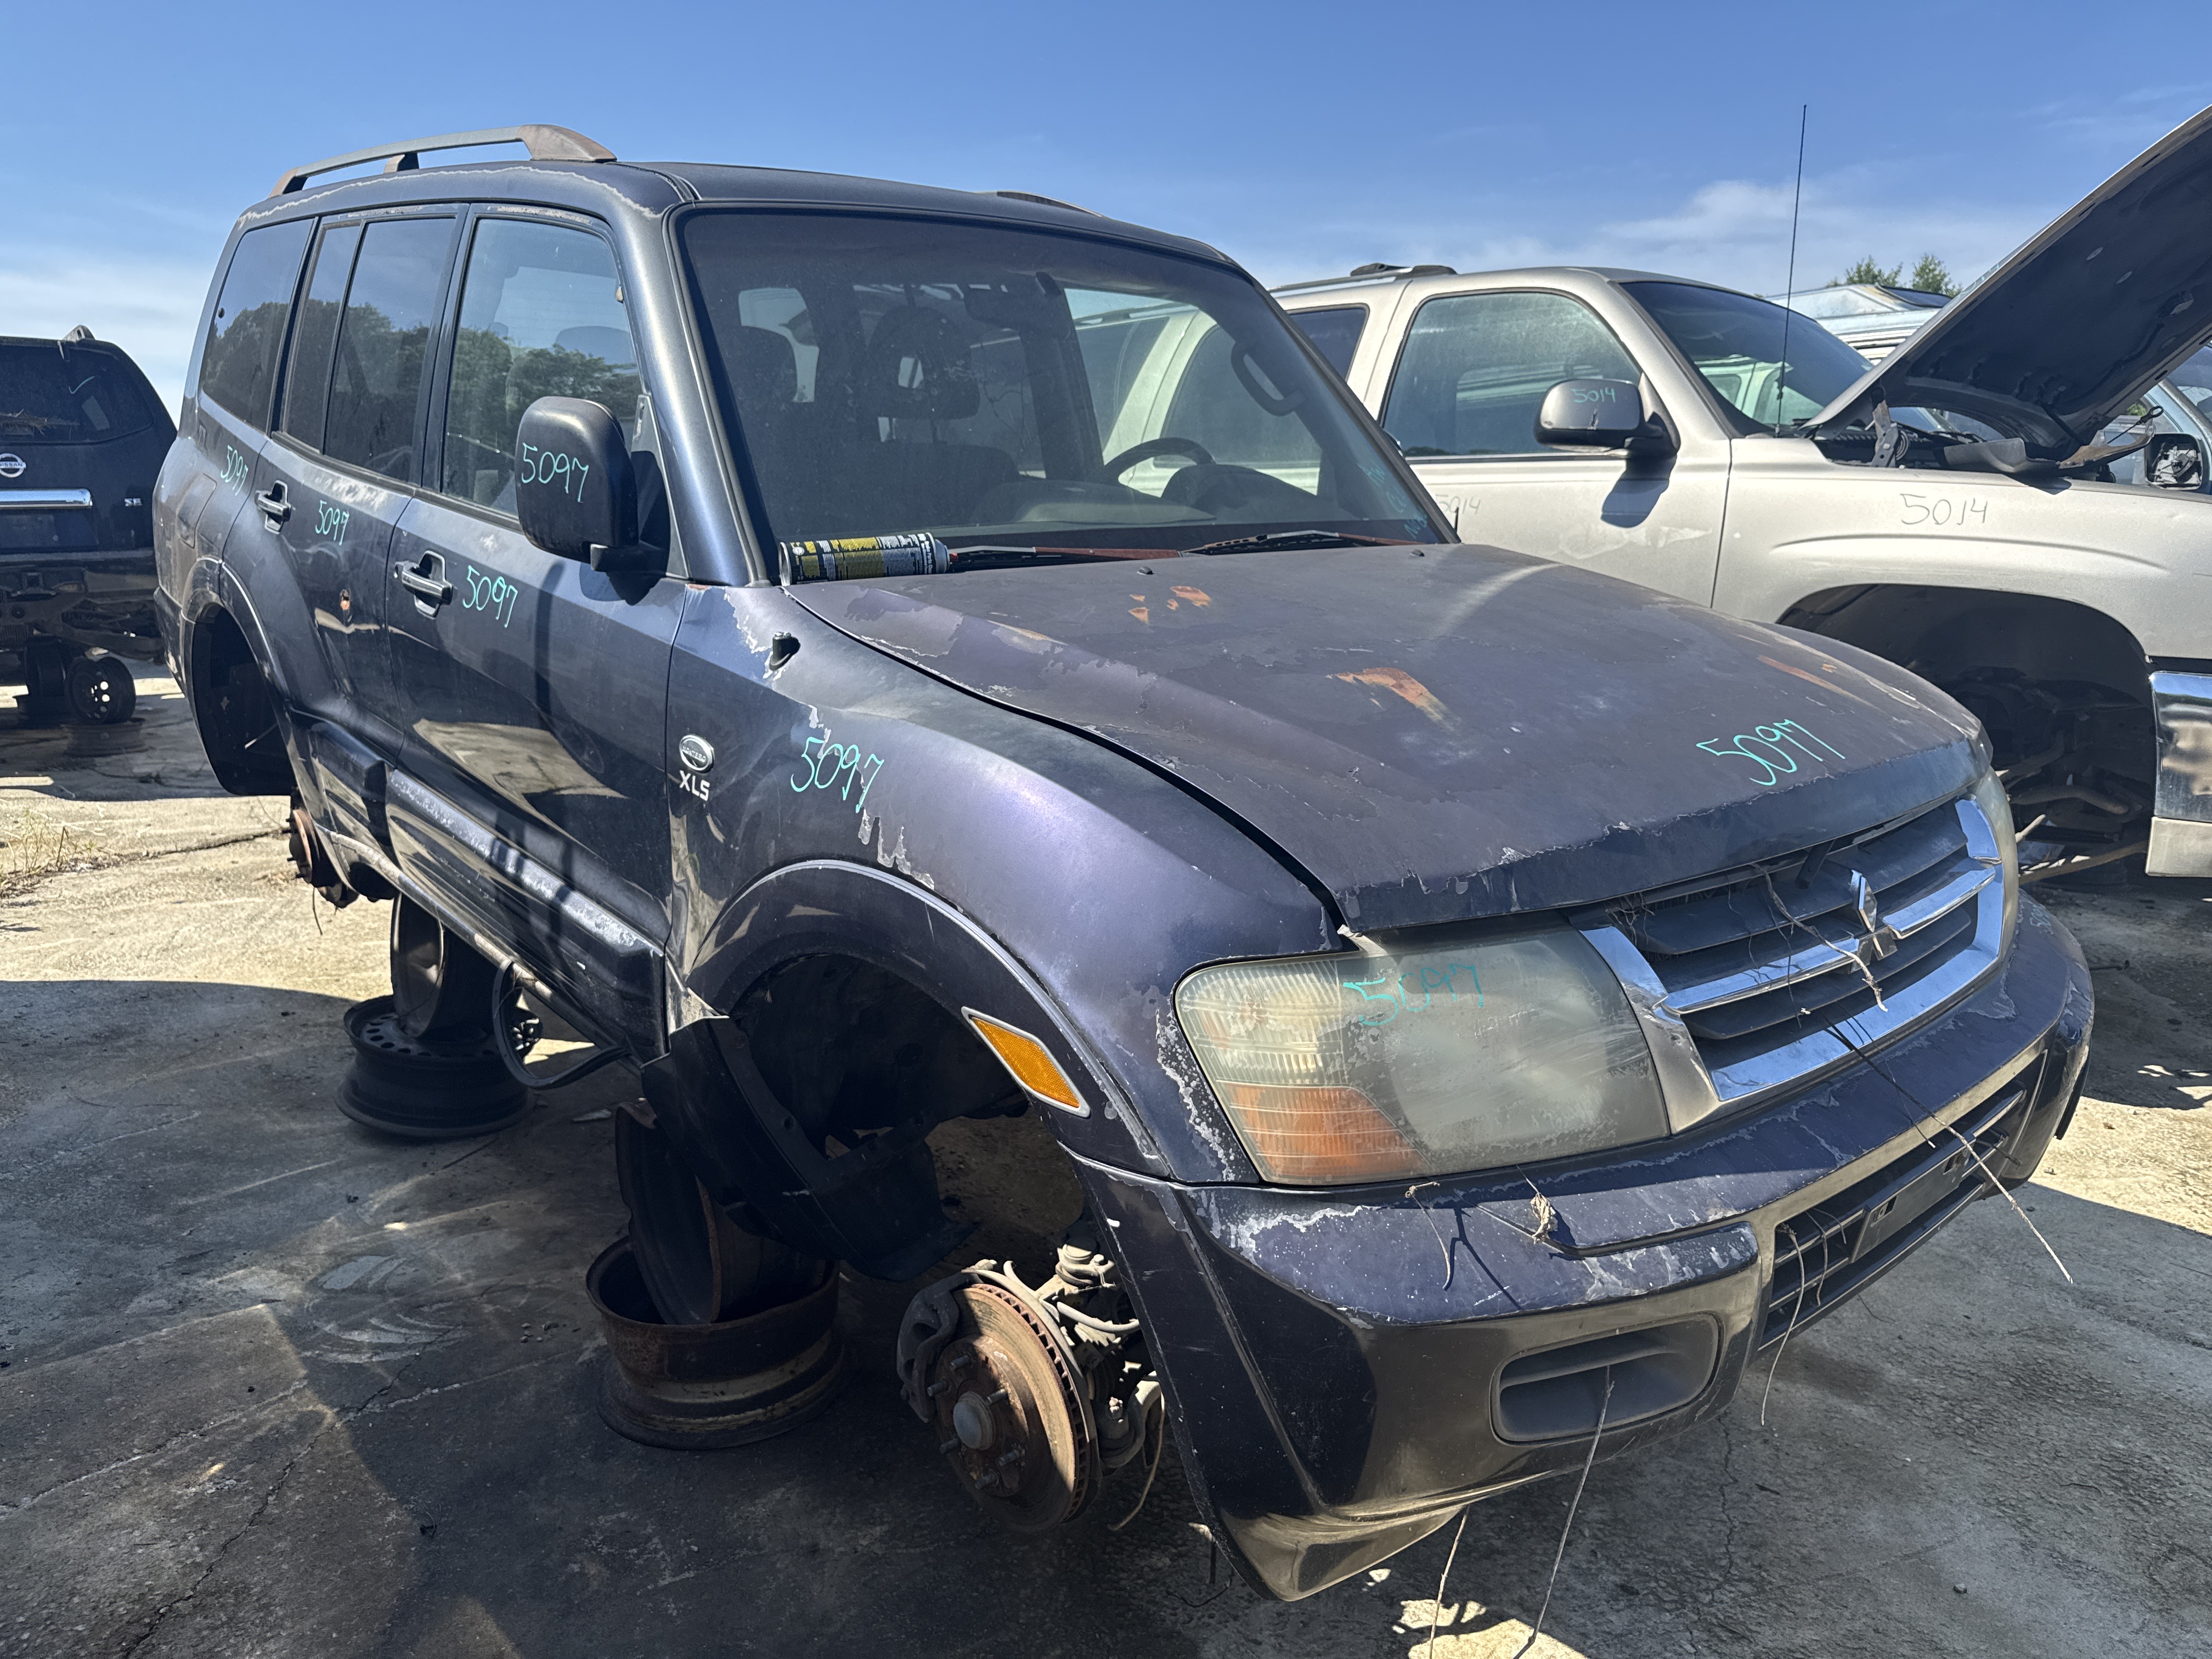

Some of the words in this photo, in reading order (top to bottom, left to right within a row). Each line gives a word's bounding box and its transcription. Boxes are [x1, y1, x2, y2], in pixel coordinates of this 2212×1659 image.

[1571, 386, 1616, 403] 5014
[221, 445, 249, 496] 5097
[521, 442, 589, 503] 5097
[315, 499, 350, 546] 5097
[1435, 494, 1481, 515] 5014
[1900, 493, 1989, 526] 5014
[462, 565, 518, 628] 5097
[791, 736, 884, 814] 5097
[1696, 719, 1846, 786] 5097
[679, 770, 710, 802] XLS
[1343, 963, 1484, 1026] 5097
